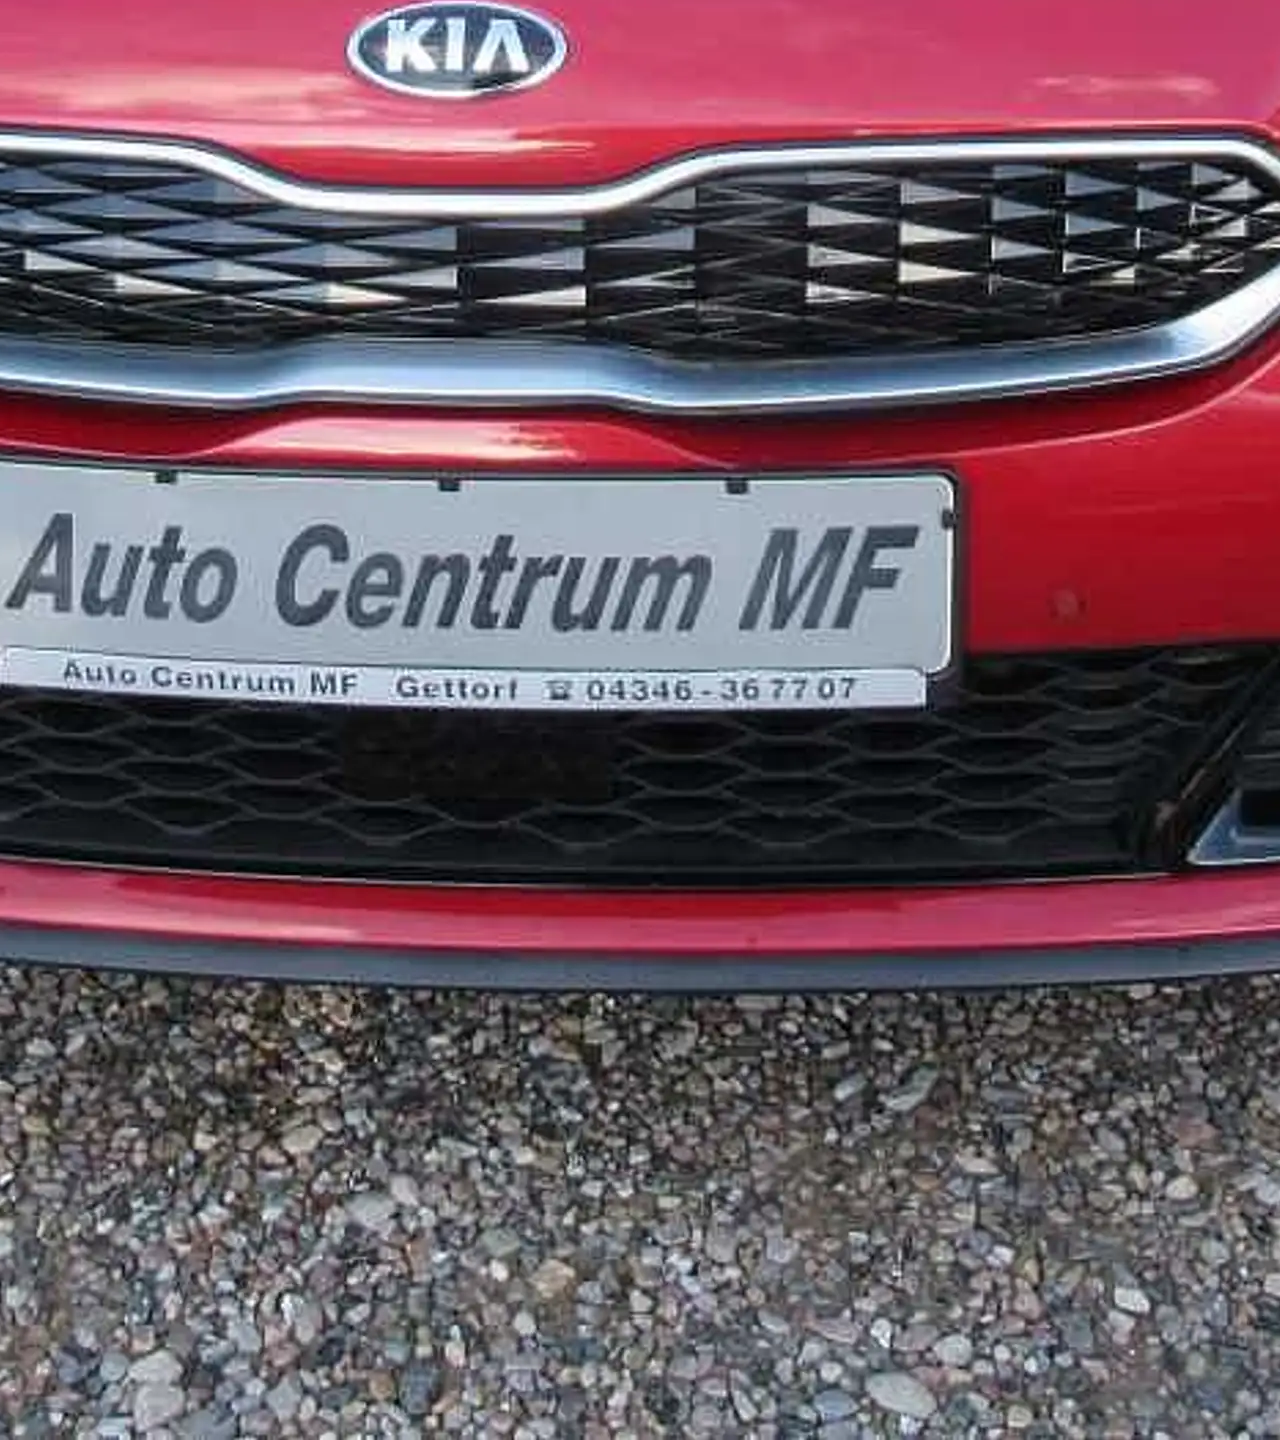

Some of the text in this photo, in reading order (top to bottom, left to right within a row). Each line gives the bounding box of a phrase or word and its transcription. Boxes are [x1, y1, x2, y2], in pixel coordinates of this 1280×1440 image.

[385, 17, 531, 73] KIA
[4, 512, 920, 633] Auto Centrum MF
[63, 661, 137, 685] Auto
[150, 666, 296, 695] Centrum
[310, 671, 358, 696] MF
[396, 675, 519, 701] Gettorf
